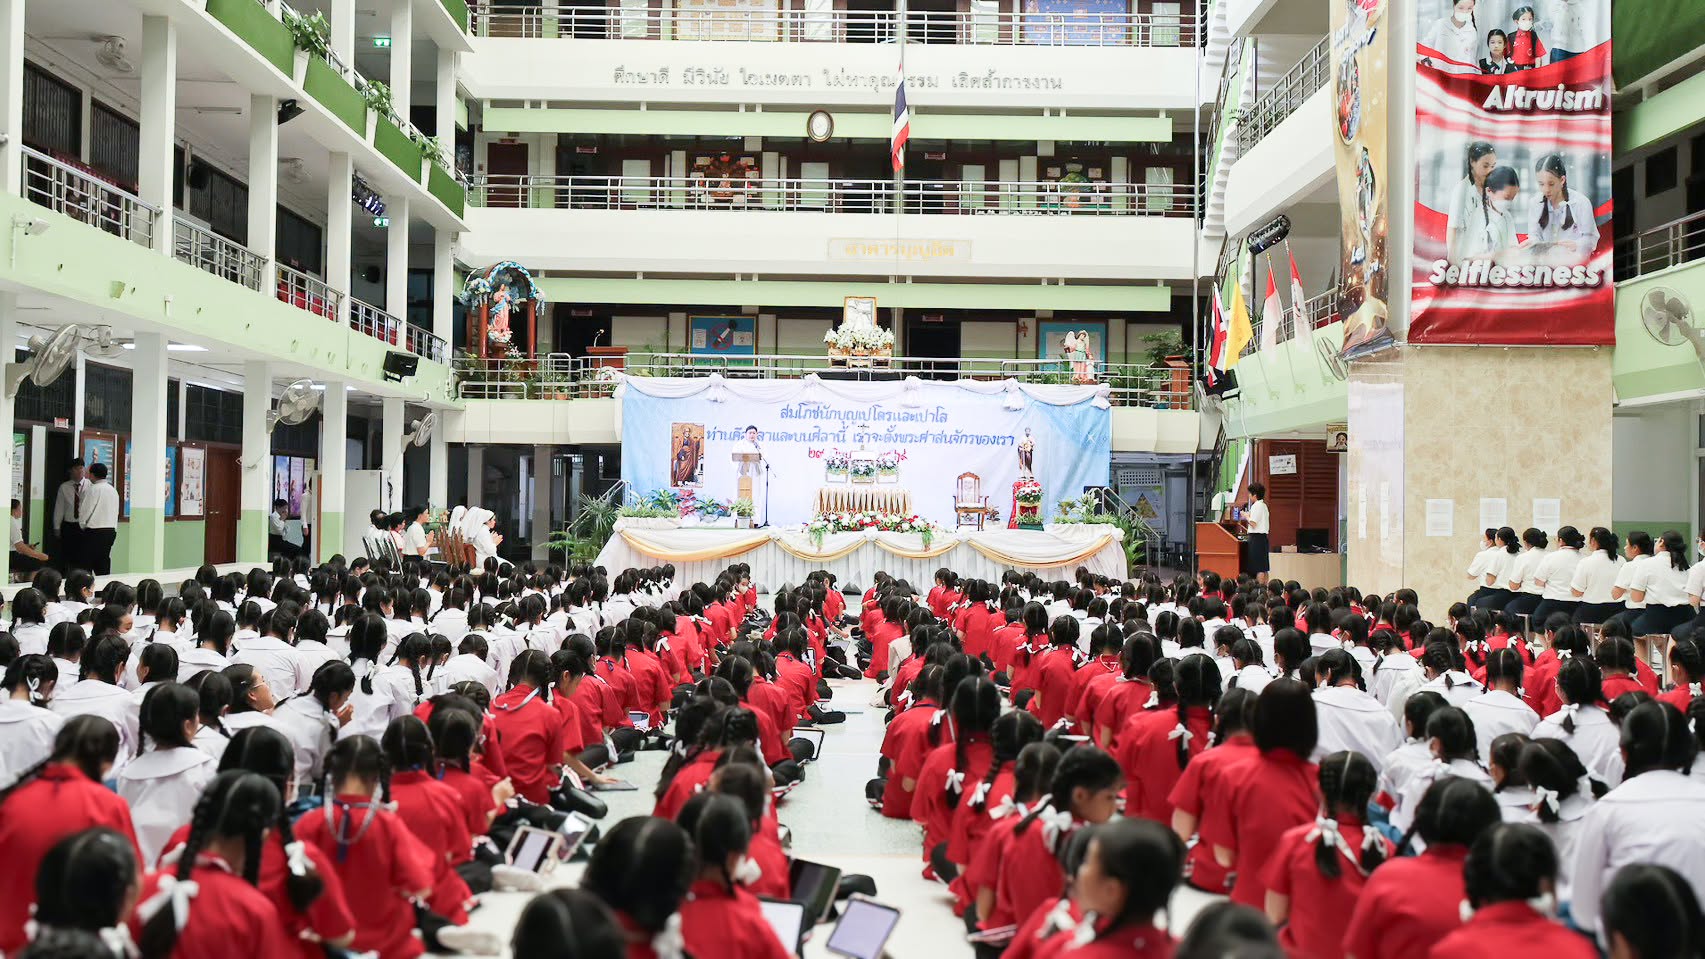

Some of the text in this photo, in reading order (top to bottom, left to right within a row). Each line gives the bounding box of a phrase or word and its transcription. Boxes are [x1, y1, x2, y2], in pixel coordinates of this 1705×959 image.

[613, 65, 670, 84] ศึกษาดี
[681, 67, 729, 85] มีวินัย
[822, 67, 939, 94] ใฝ่หาคุณรรม
[1483, 84, 1604, 112] Altruism
[1429, 258, 1601, 289] Selflessness
[780, 403, 948, 425] สมโภชนักบุญเปโตรและเปาโล
[706, 421, 847, 443] ท่านคือลาและบนศิลานี้
